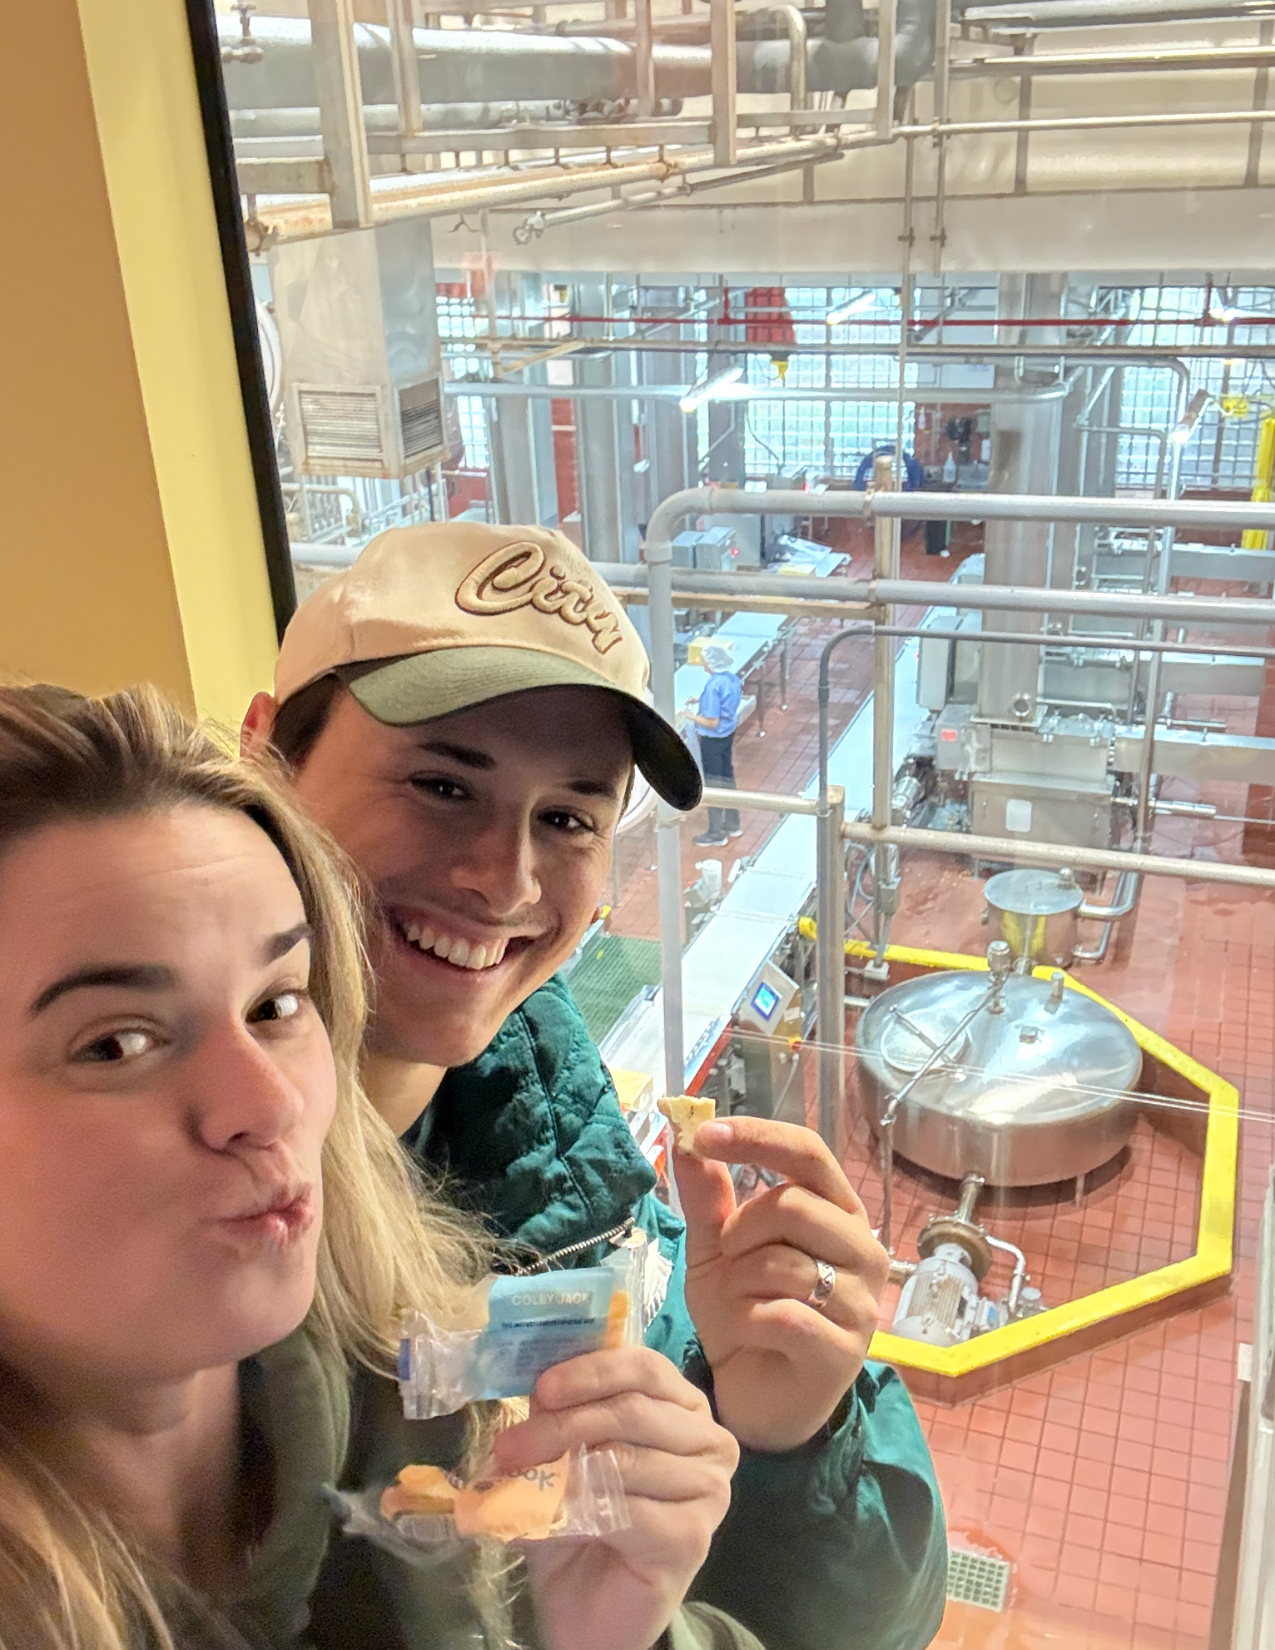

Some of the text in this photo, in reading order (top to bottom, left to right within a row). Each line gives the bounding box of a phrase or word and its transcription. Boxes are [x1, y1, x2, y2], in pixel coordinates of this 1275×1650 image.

[454, 541, 623, 655] City
[511, 1292, 589, 1307] COLBY JACK
